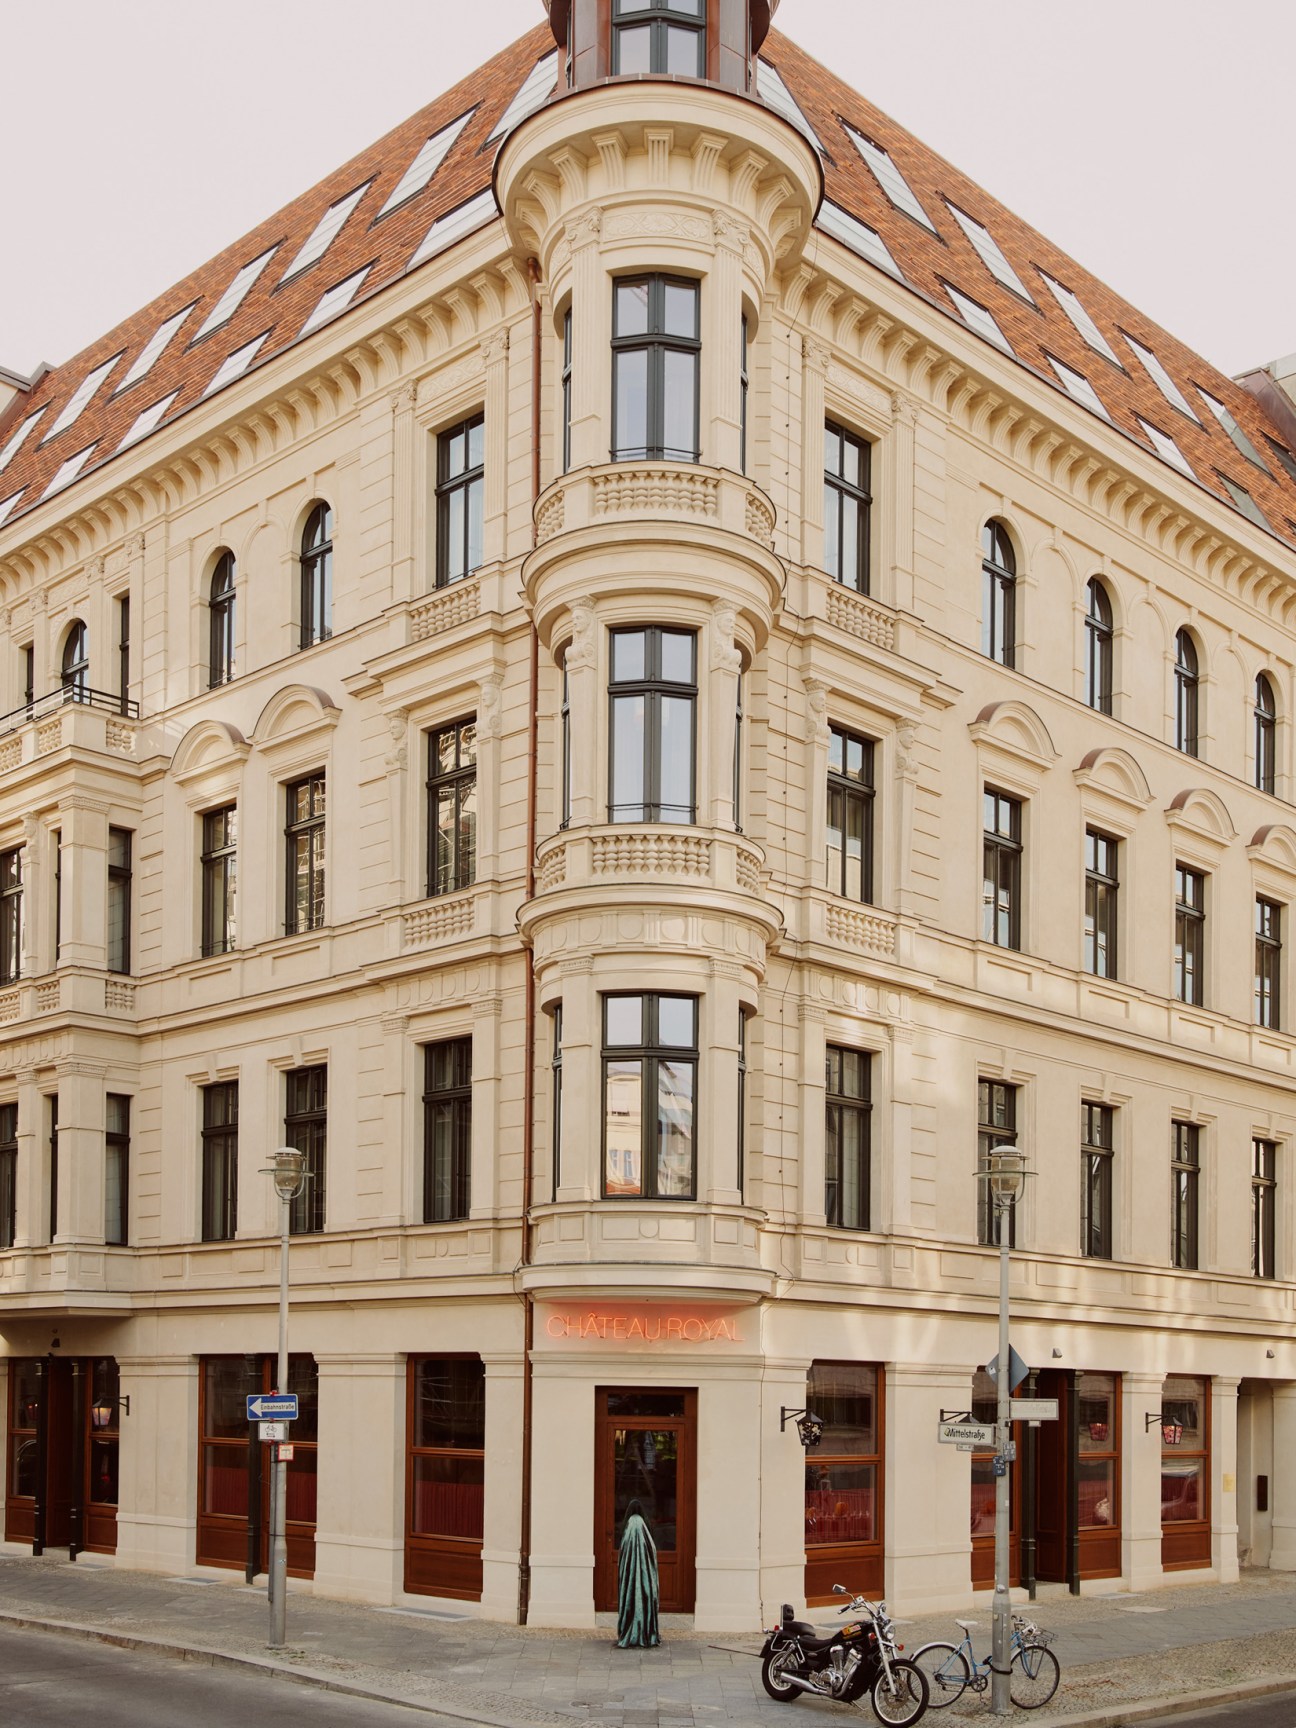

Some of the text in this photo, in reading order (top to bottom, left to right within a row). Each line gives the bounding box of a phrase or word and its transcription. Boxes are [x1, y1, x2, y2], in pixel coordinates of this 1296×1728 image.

[546, 1312, 745, 1342] CHÂTEAU ROYAL
[948, 1427, 985, 1440] Mittelstraße
